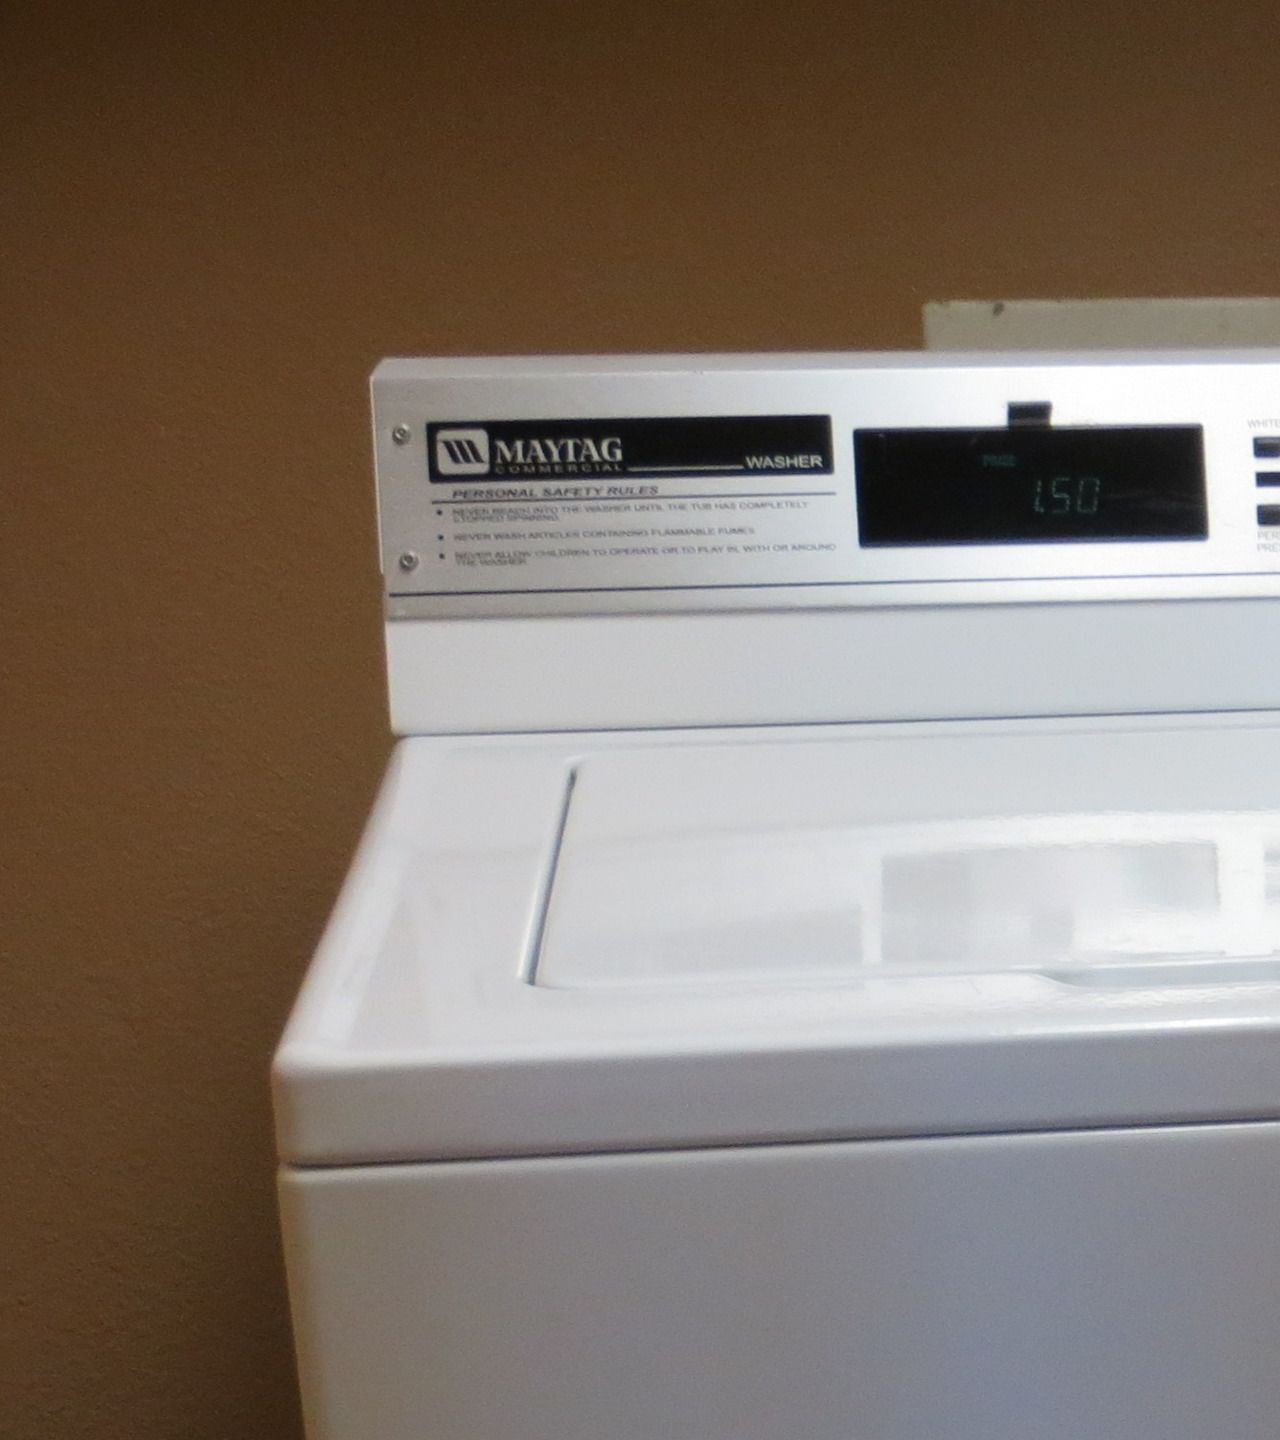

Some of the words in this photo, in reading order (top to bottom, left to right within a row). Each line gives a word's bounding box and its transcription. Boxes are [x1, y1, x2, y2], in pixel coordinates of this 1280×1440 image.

[494, 437, 623, 463] MAYTAG
[496, 463, 623, 473] COMMERCIAL
[745, 454, 823, 469] WASHER
[452, 488, 538, 498] PERSONAL
[543, 487, 601, 497] SAFETY
[607, 486, 658, 496] RULES
